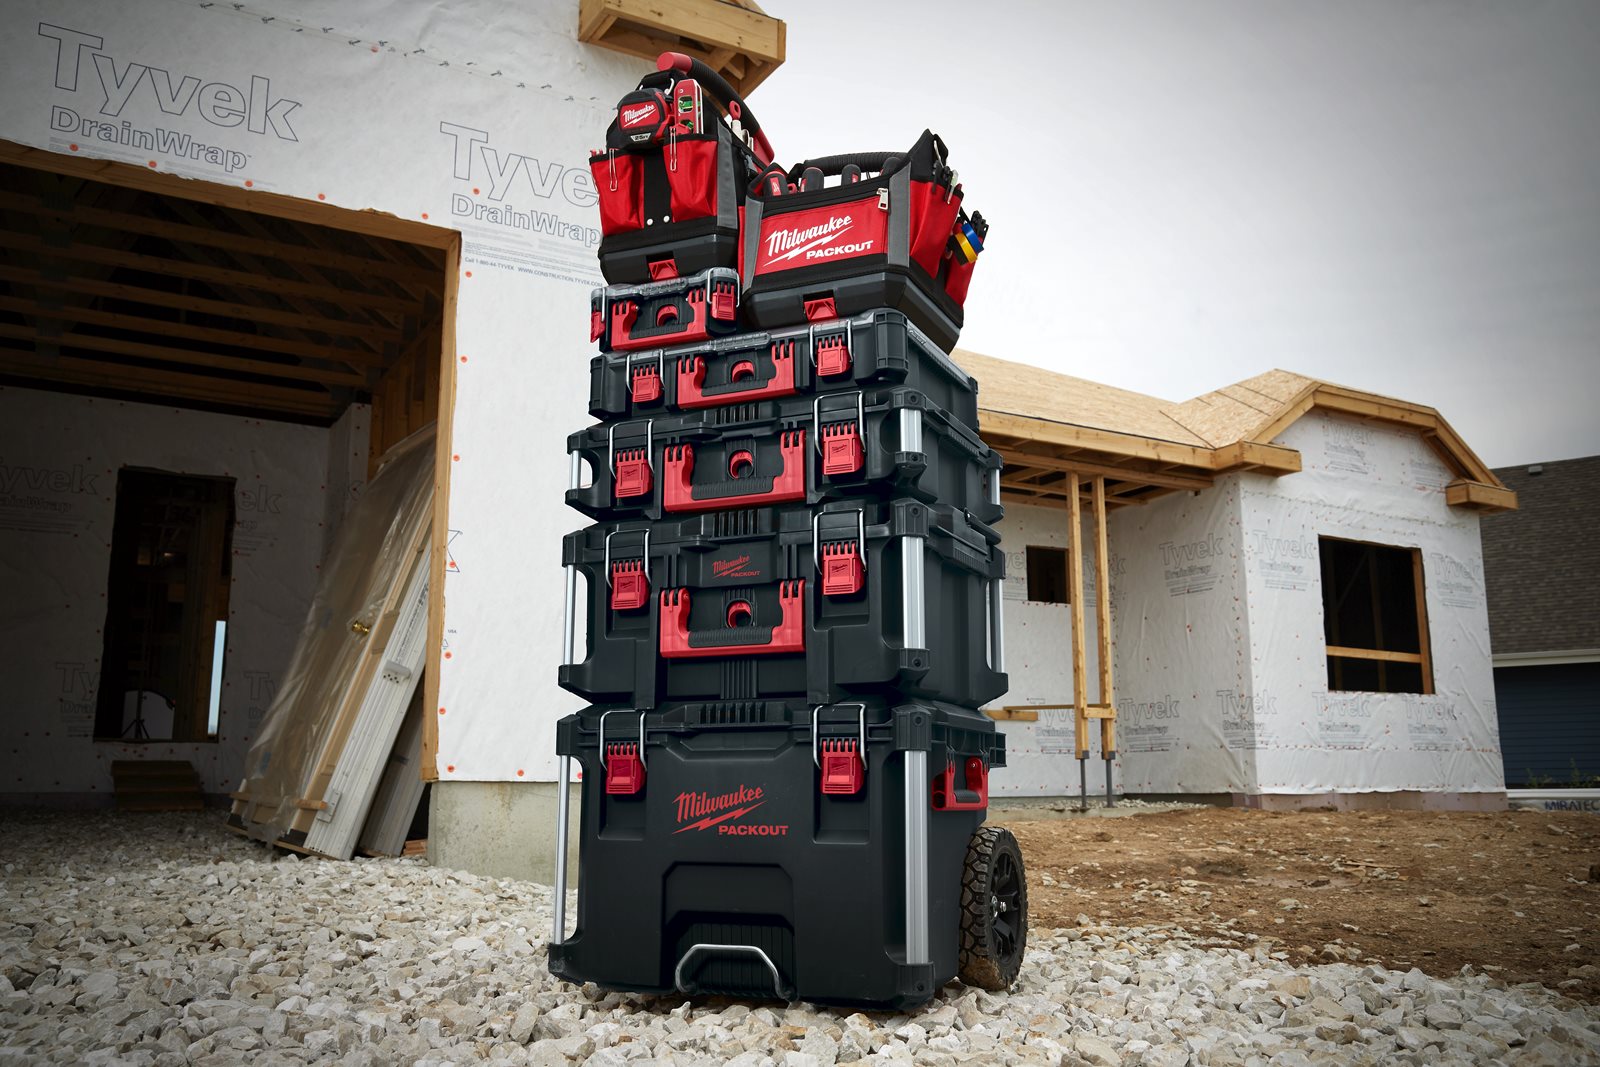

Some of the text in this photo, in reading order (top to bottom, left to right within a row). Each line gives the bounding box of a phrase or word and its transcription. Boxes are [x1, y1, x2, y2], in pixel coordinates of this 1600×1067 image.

[38, 22, 301, 143] Tyvek
[623, 104, 655, 122] Milwaukee
[50, 105, 247, 173] DrainWrap
[440, 121, 600, 207] Tyve
[452, 193, 600, 248] DrainWrap
[765, 215, 852, 257] Milwaukee
[806, 240, 874, 260] PACKOUT
[0, 456, 99, 497] yvek
[1159, 533, 1224, 569] Tyvek
[1252, 529, 1314, 561] Tyvek
[730, 570, 760, 578] PACKOUT
[1119, 694, 1180, 727] Tyvek
[672, 784, 764, 823] Milwaukee
[719, 825, 789, 836] PACKOUT
